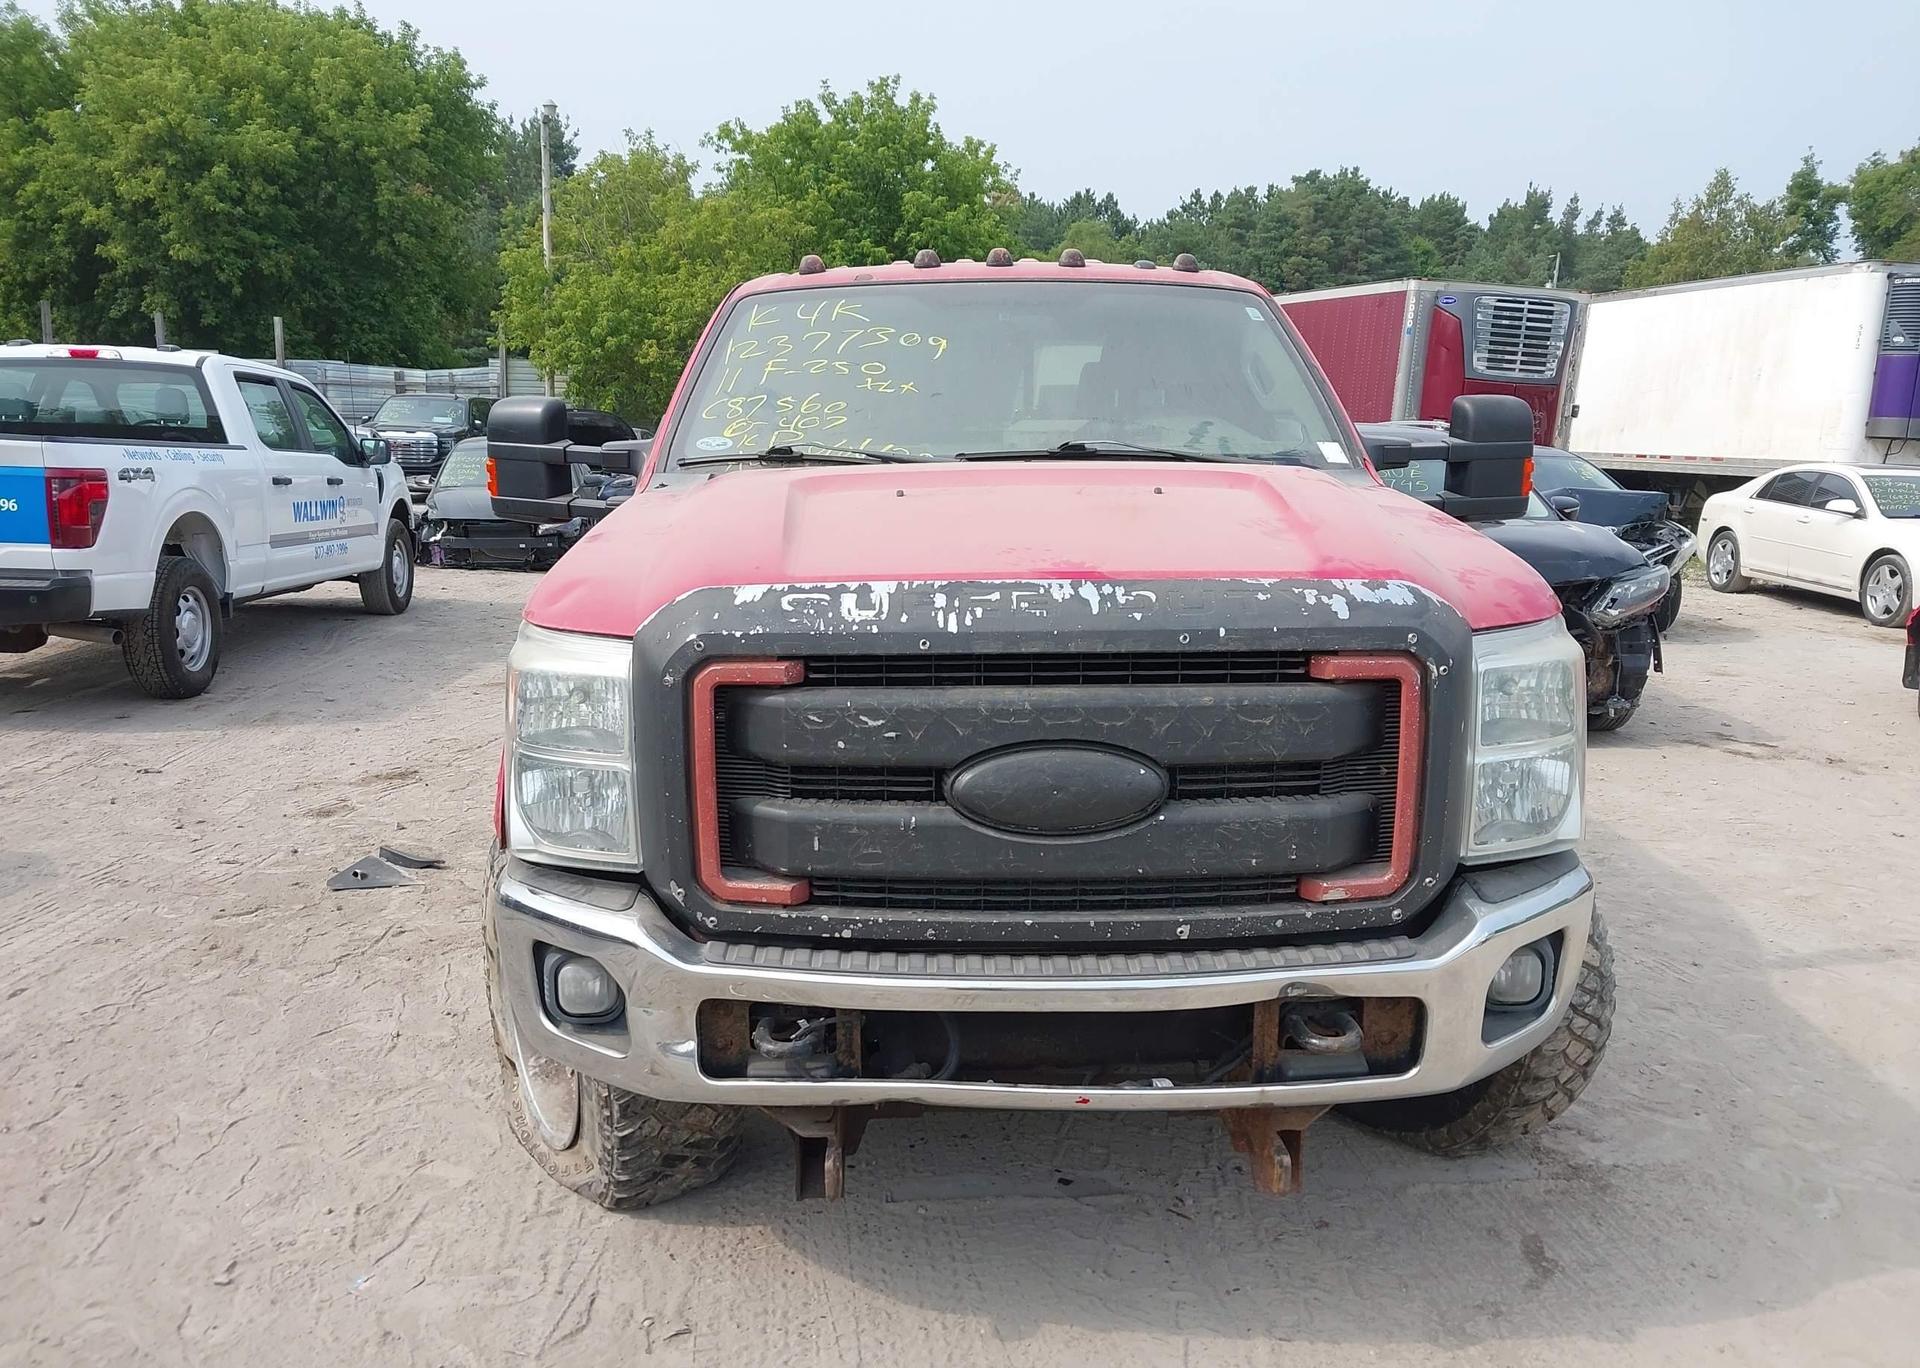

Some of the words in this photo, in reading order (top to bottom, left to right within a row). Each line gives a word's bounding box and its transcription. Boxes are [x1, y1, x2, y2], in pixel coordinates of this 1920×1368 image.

[748, 303, 779, 332] K
[760, 358, 887, 385] F-250
[124, 448, 162, 461] Networks
[0, 498, 18, 512] 96
[292, 499, 338, 523] WALLWIN
[314, 542, 349, 560] 877-497-1996
